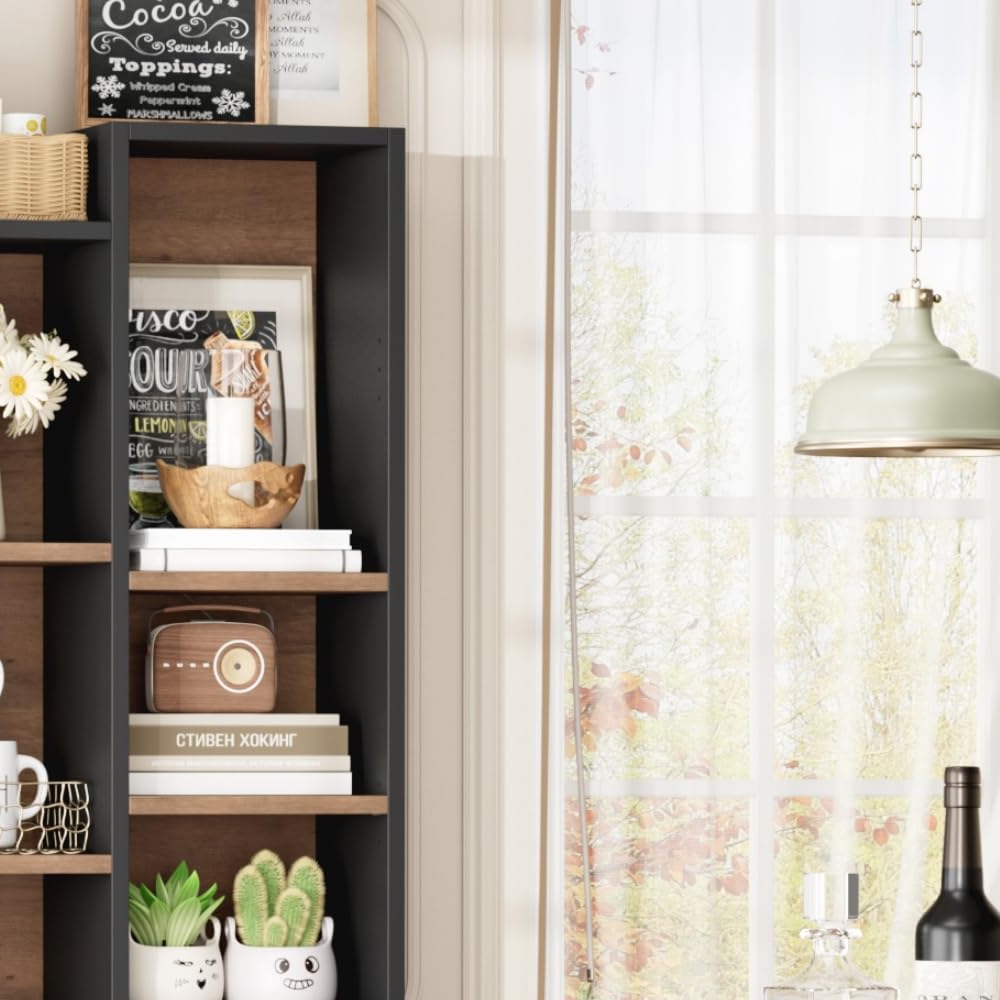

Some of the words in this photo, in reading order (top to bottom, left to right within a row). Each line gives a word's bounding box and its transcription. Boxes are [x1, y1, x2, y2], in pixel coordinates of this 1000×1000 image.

[102, 0, 214, 30] Cocoa
[166, 39, 211, 54] Served
[213, 41, 248, 60] daily
[109, 57, 232, 77] Toppings:
[129, 81, 176, 93] Whipped
[178, 83, 212, 93] Cream
[139, 95, 202, 106] Peppermint
[126, 109, 213, 120] MARSHMALLOWS
[128, 443, 154, 458] EGG
[176, 733, 235, 748] СТИВЕН
[240, 733, 297, 748] ХОКИНГ
